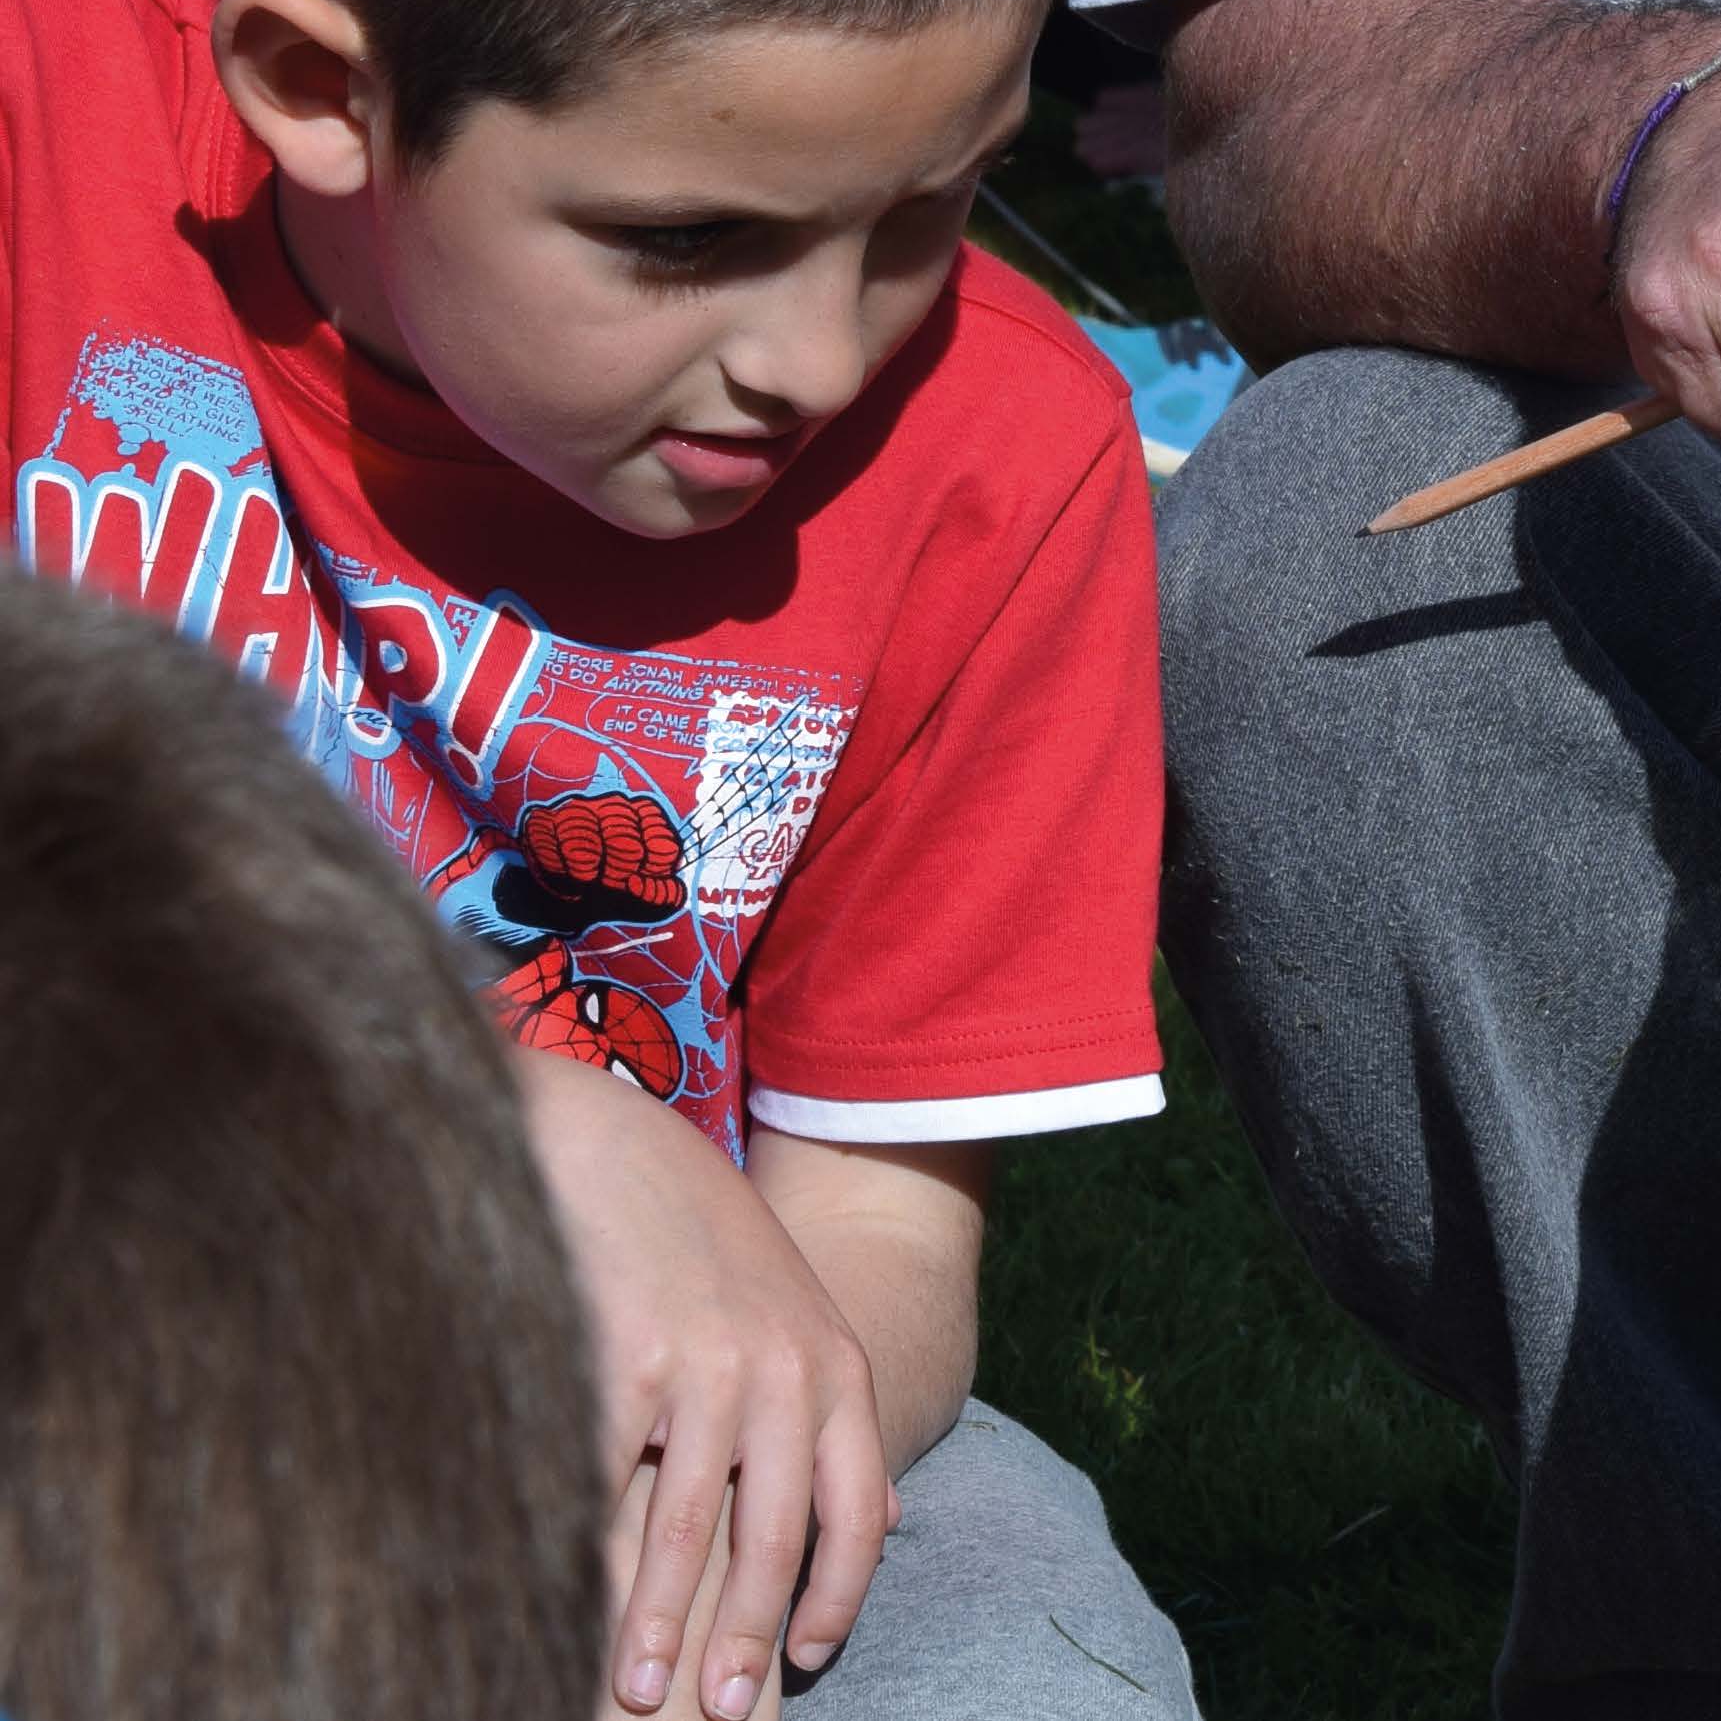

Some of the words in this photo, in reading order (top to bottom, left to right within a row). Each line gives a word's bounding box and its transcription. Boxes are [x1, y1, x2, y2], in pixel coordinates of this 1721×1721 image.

[179, 396, 199, 411] TO
[205, 407, 248, 433] GIVE
[203, 389, 241, 414] HE'S
[546, 648, 614, 673] BEFORE
[623, 662, 684, 683] JONAH
[546, 662, 564, 676] TO
[570, 668, 597, 685] DO
[603, 676, 705, 701] ANYTHING
[616, 704, 634, 715] IT
[637, 708, 691, 729] CAME
[604, 718, 637, 734] END
[643, 725, 669, 741] OF
[671, 730, 706, 749] THIS
